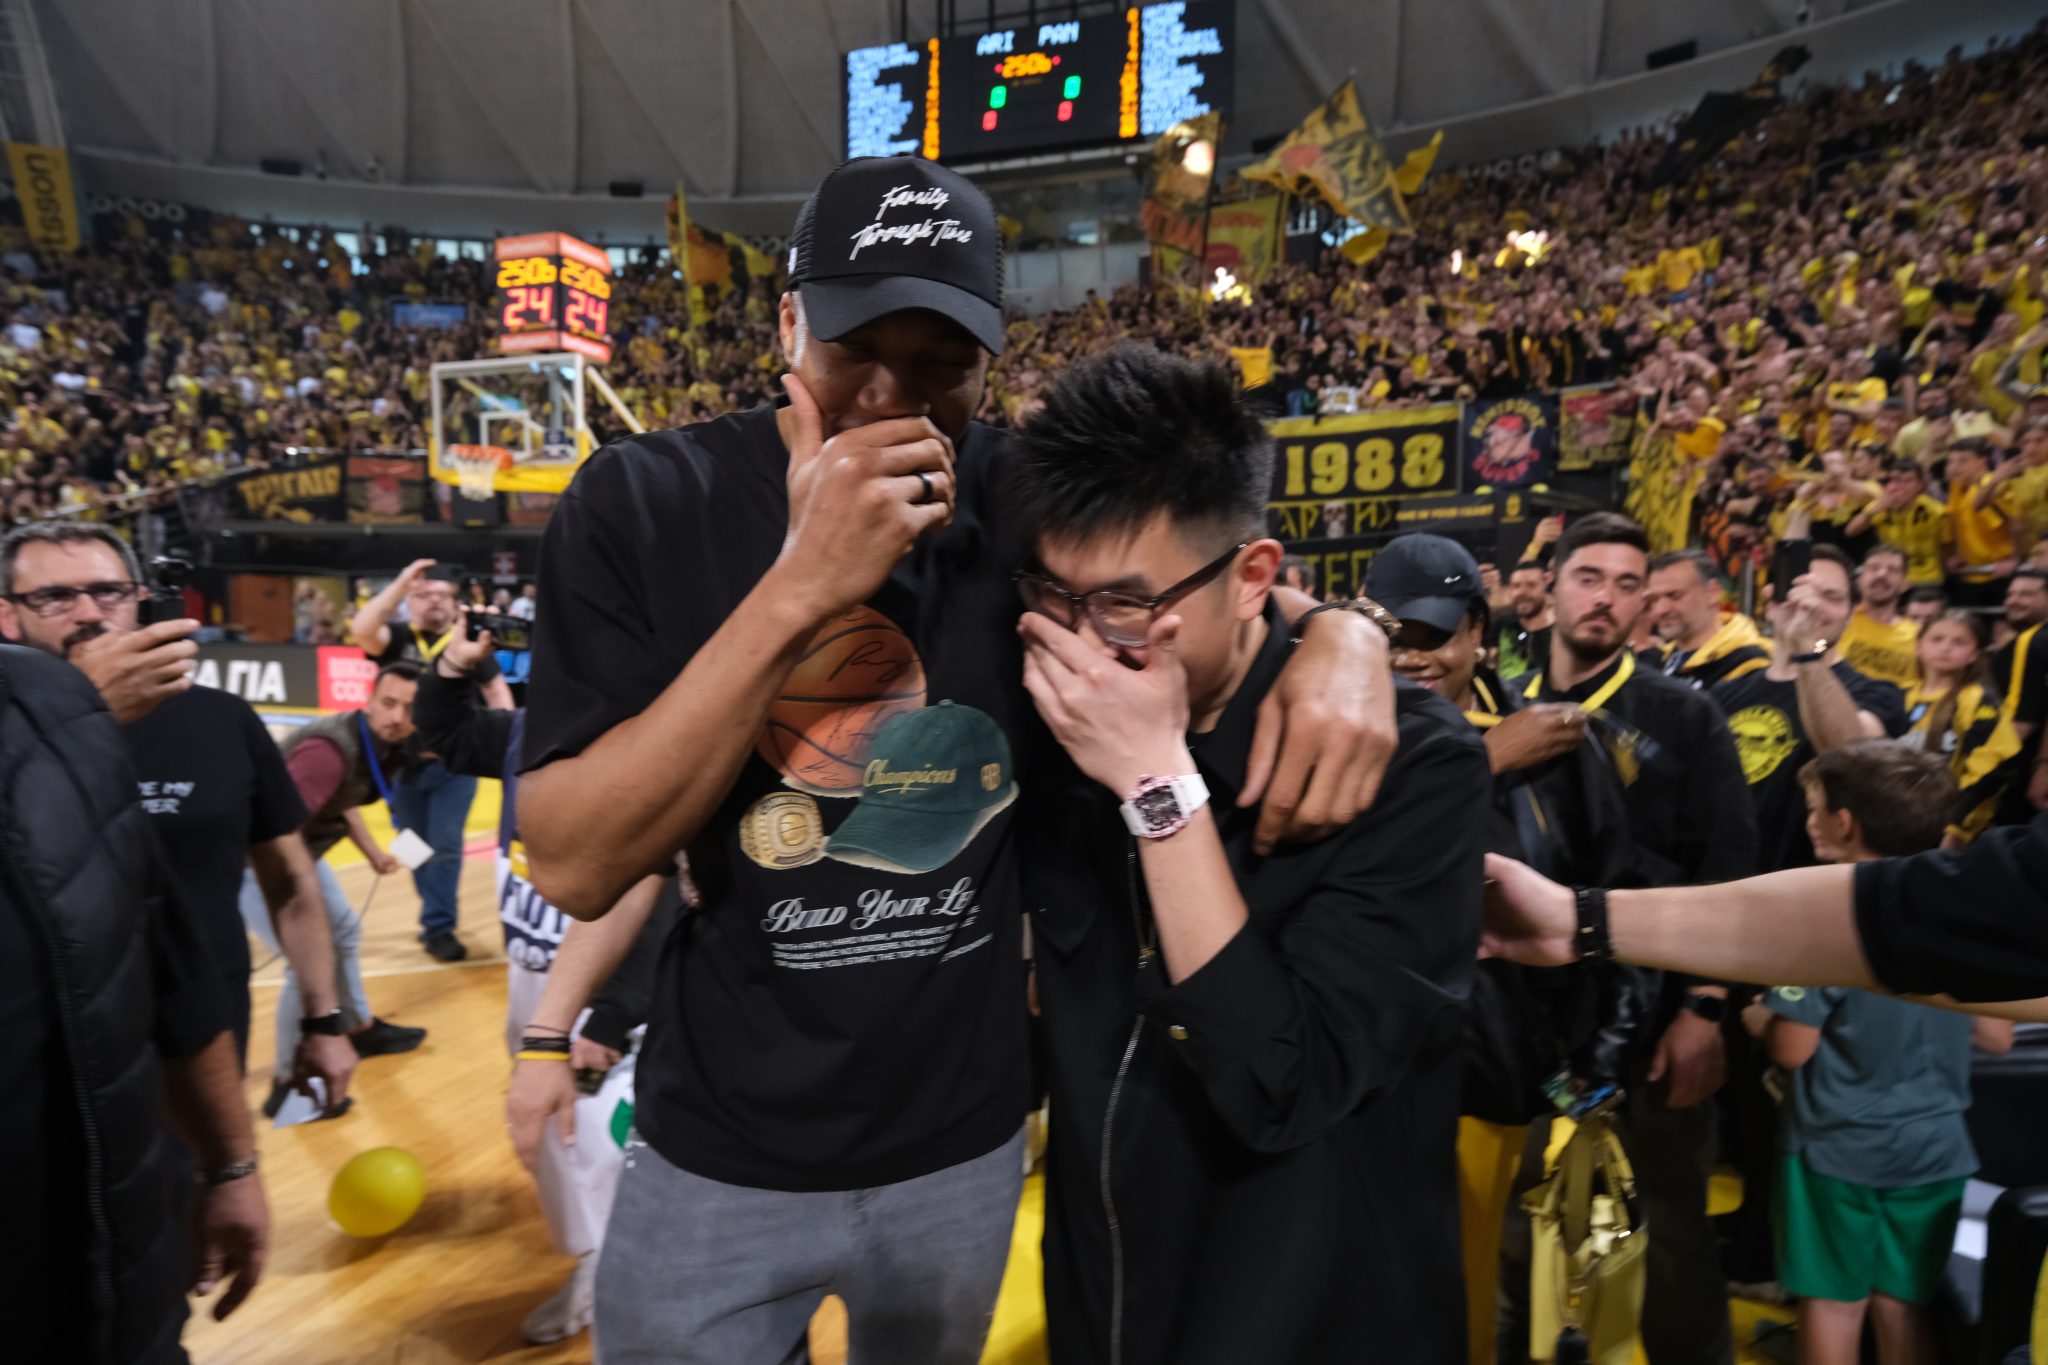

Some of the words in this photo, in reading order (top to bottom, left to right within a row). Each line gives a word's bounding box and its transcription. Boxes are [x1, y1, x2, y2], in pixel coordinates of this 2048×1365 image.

[875, 185, 950, 220] Family
[849, 218, 933, 260] Through
[930, 218, 974, 246] Time
[503, 286, 554, 328] 24
[565, 288, 609, 336] 24
[1284, 433, 1446, 497] 1988
[863, 758, 959, 795] Champions
